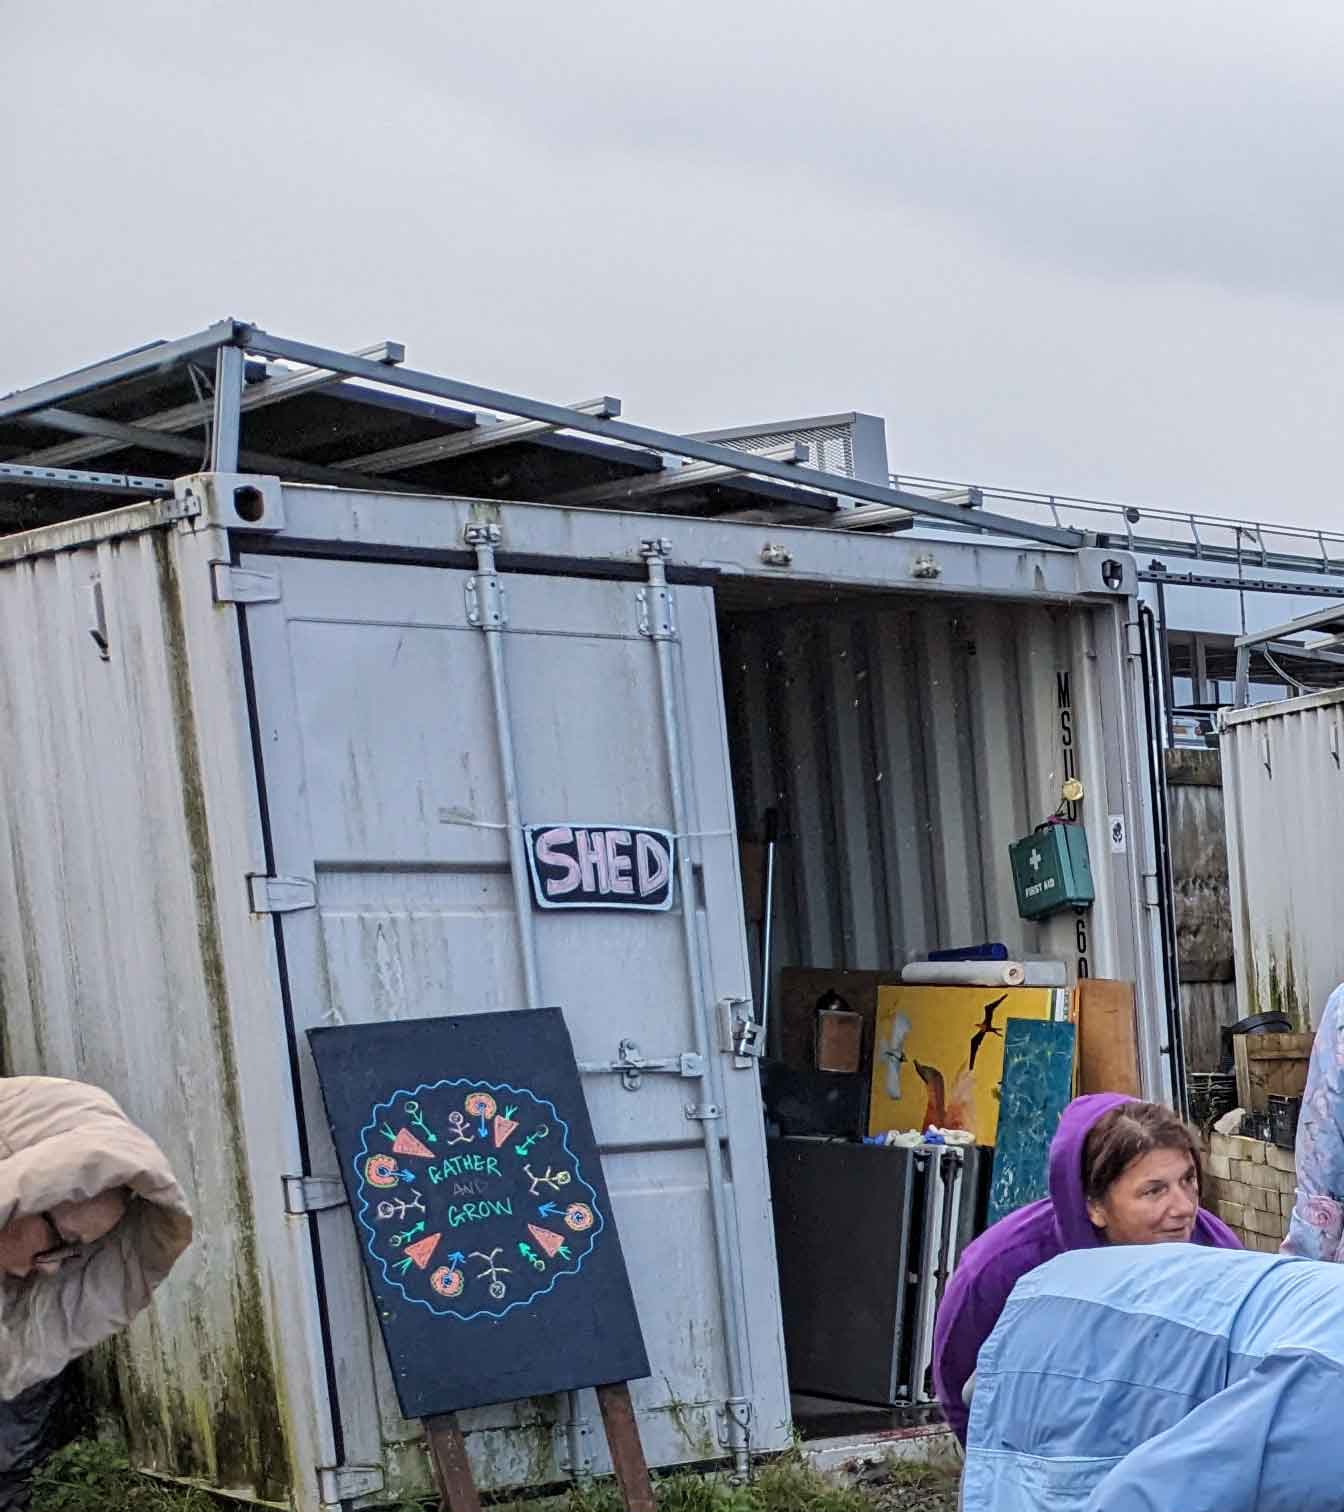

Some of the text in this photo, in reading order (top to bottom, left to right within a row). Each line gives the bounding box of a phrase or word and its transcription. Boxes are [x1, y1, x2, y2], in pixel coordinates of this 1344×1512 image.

[536, 827, 670, 896] SHED
[1025, 878, 1055, 898] FIRST AID
[428, 1154, 502, 1184] GATHER
[453, 1182, 488, 1196] AND
[448, 1196, 512, 1227] GROW
